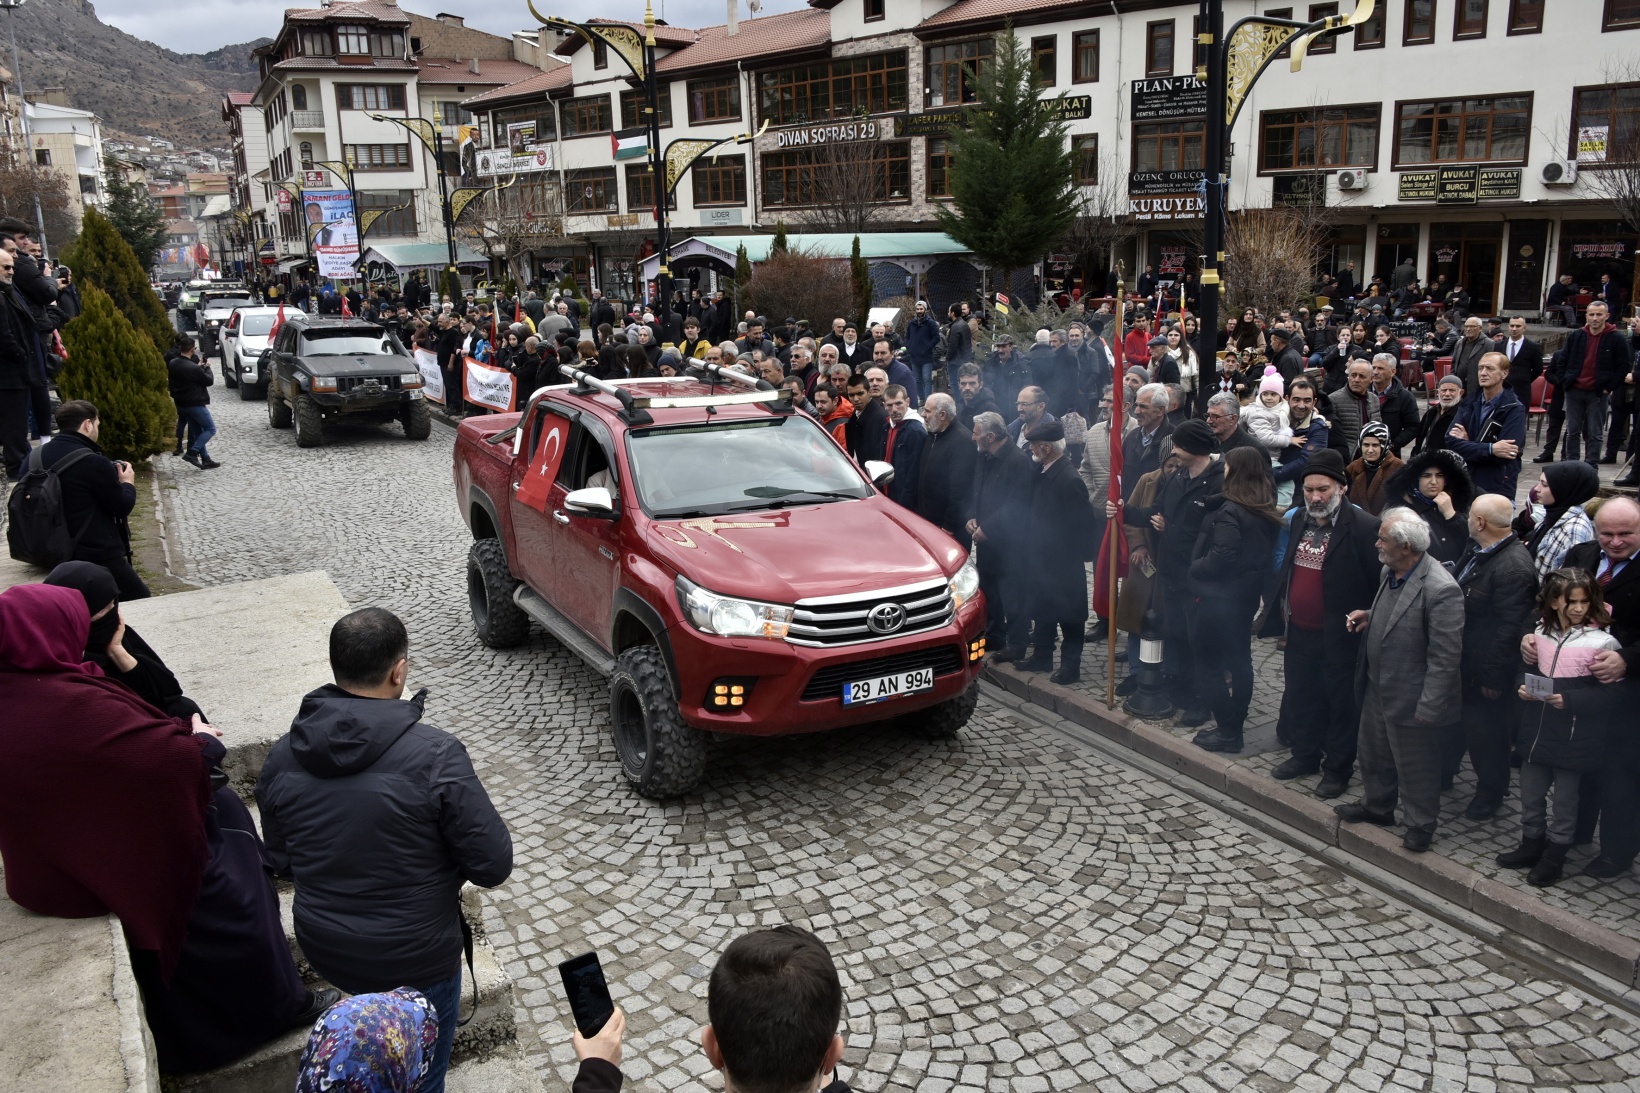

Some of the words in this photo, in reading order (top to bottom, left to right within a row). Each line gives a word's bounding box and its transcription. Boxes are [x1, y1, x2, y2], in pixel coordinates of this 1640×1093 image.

[1133, 173, 1164, 182] ÖZENÇ
[1401, 174, 1436, 182] AVUKAT
[1442, 170, 1475, 179] AVUKAT
[1446, 183, 1469, 191] BURCU
[852, 682, 871, 701] 29
[877, 676, 899, 696] AN
[905, 670, 932, 690] 994
